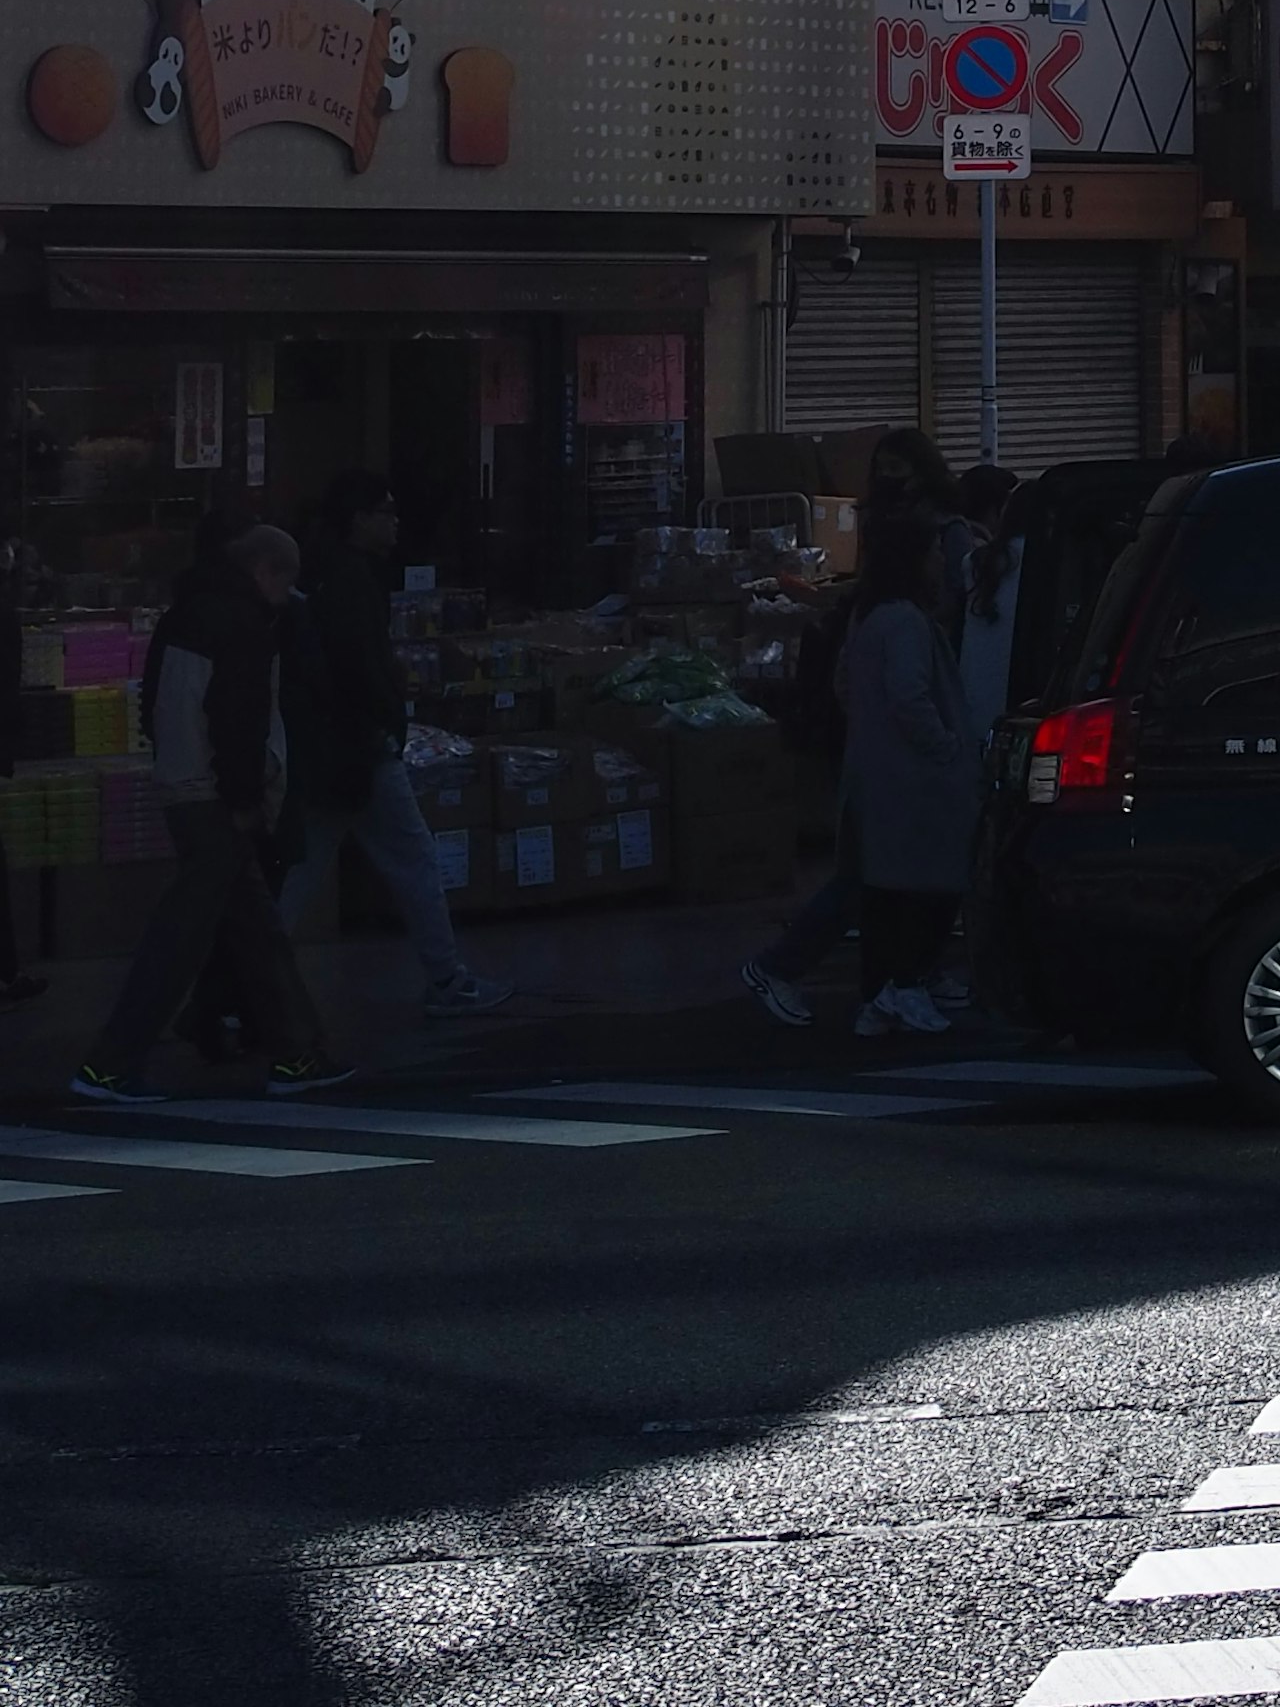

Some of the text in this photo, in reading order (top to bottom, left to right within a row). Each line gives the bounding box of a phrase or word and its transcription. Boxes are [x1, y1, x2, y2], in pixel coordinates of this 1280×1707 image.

[221, 84, 355, 127] NIKI BAKERY & CAFE
[951, 141, 1024, 158] 貨物を除く
